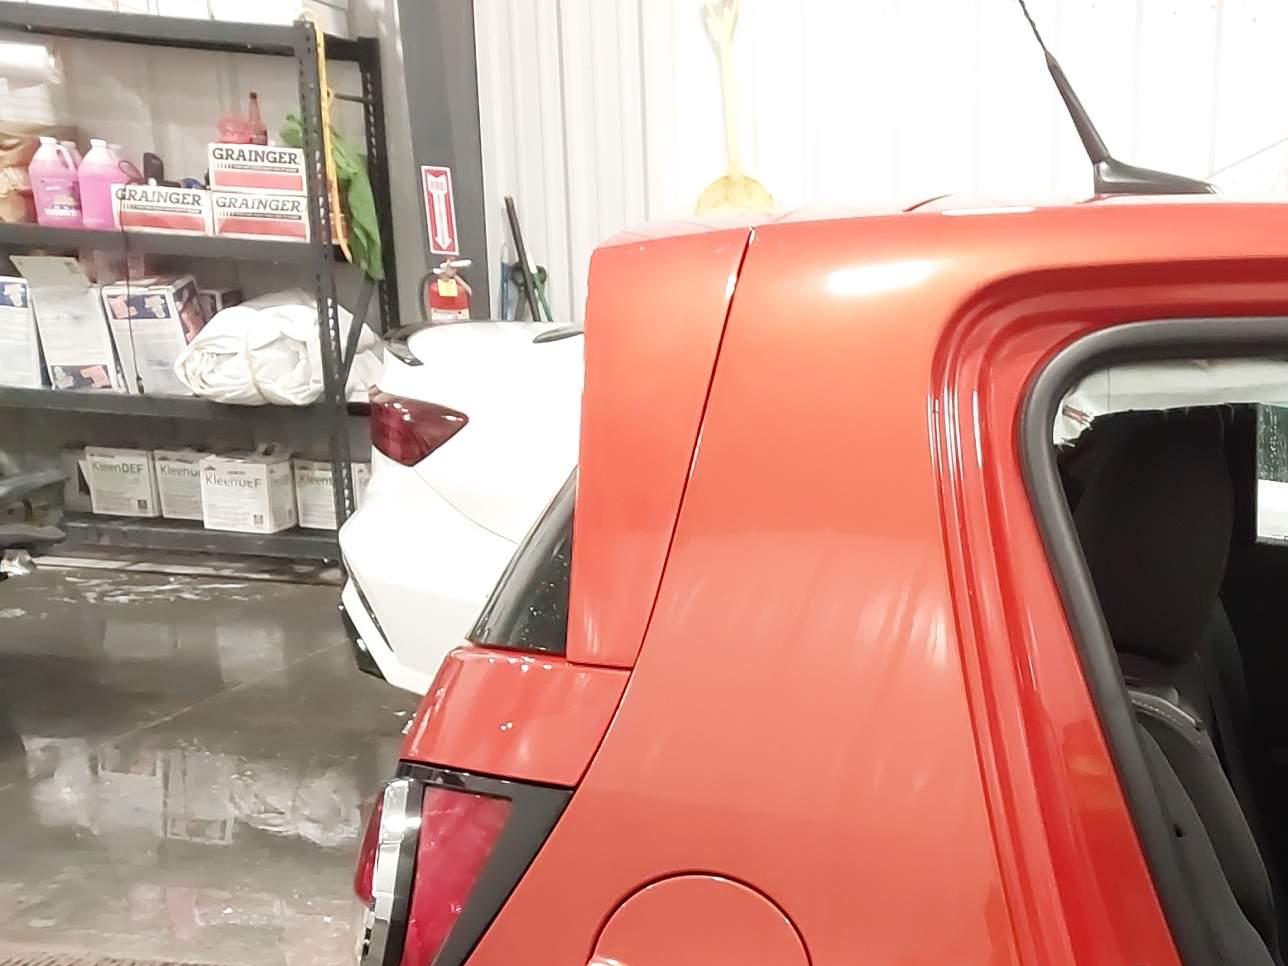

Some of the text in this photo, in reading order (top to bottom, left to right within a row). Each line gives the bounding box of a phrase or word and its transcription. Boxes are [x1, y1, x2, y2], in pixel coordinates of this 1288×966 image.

[212, 147, 298, 165] GRAINGER
[115, 188, 201, 206] GRAINGER
[216, 196, 301, 213] GRAINGER
[92, 461, 144, 474] KleenDEF
